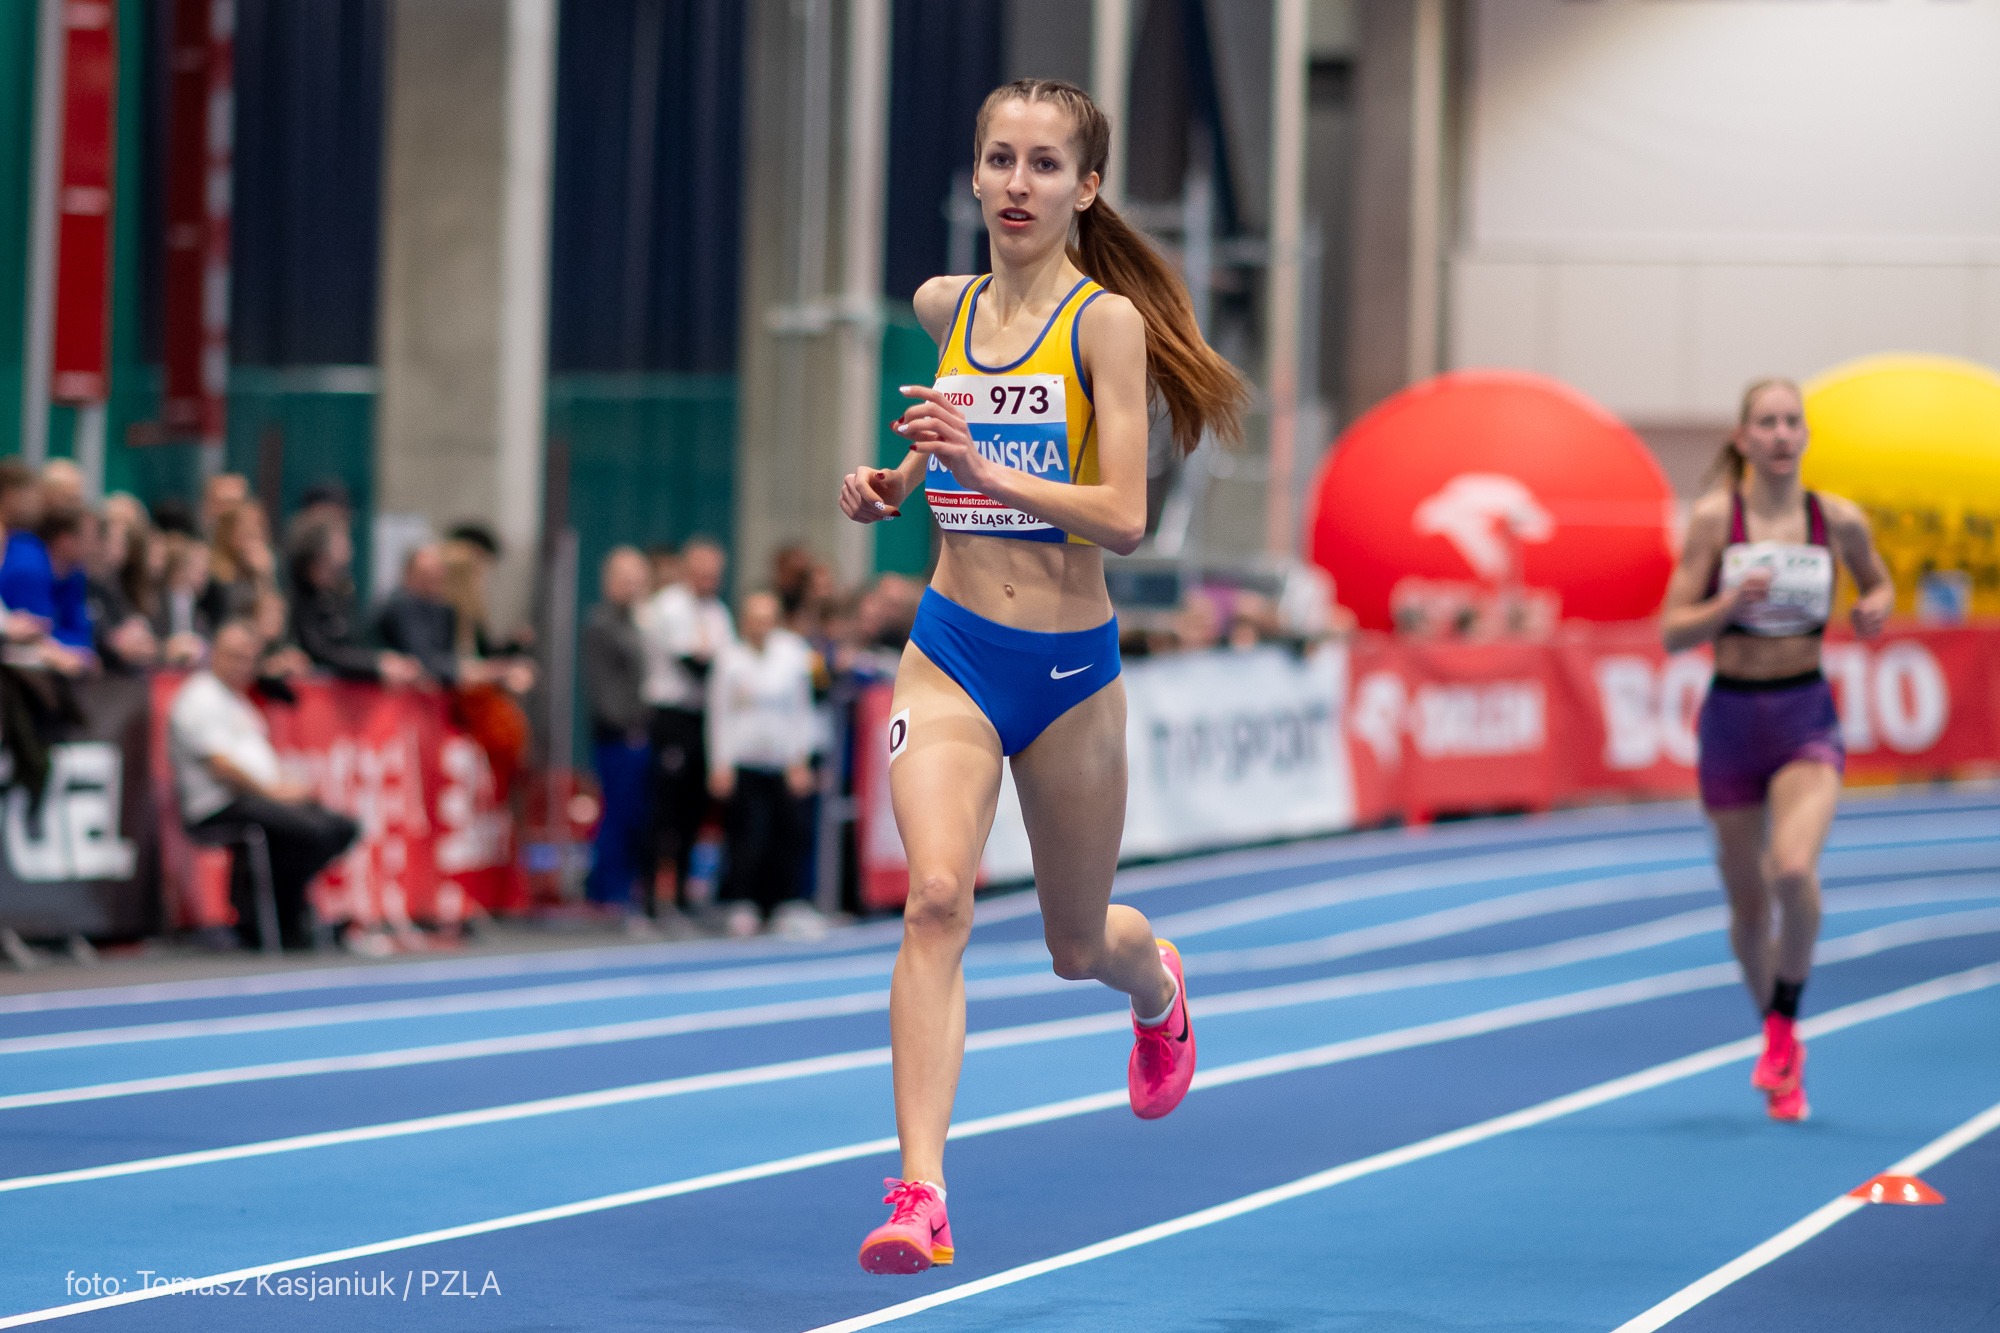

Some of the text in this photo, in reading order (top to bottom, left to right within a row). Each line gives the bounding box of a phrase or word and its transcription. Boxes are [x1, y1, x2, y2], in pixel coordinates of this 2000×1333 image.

[943, 392, 974, 407] DZIO
[990, 385, 1049, 415] 973
[938, 496, 958, 505] Halowe
[934, 510, 1045, 527] DOLNY ŚLĄSK 20
